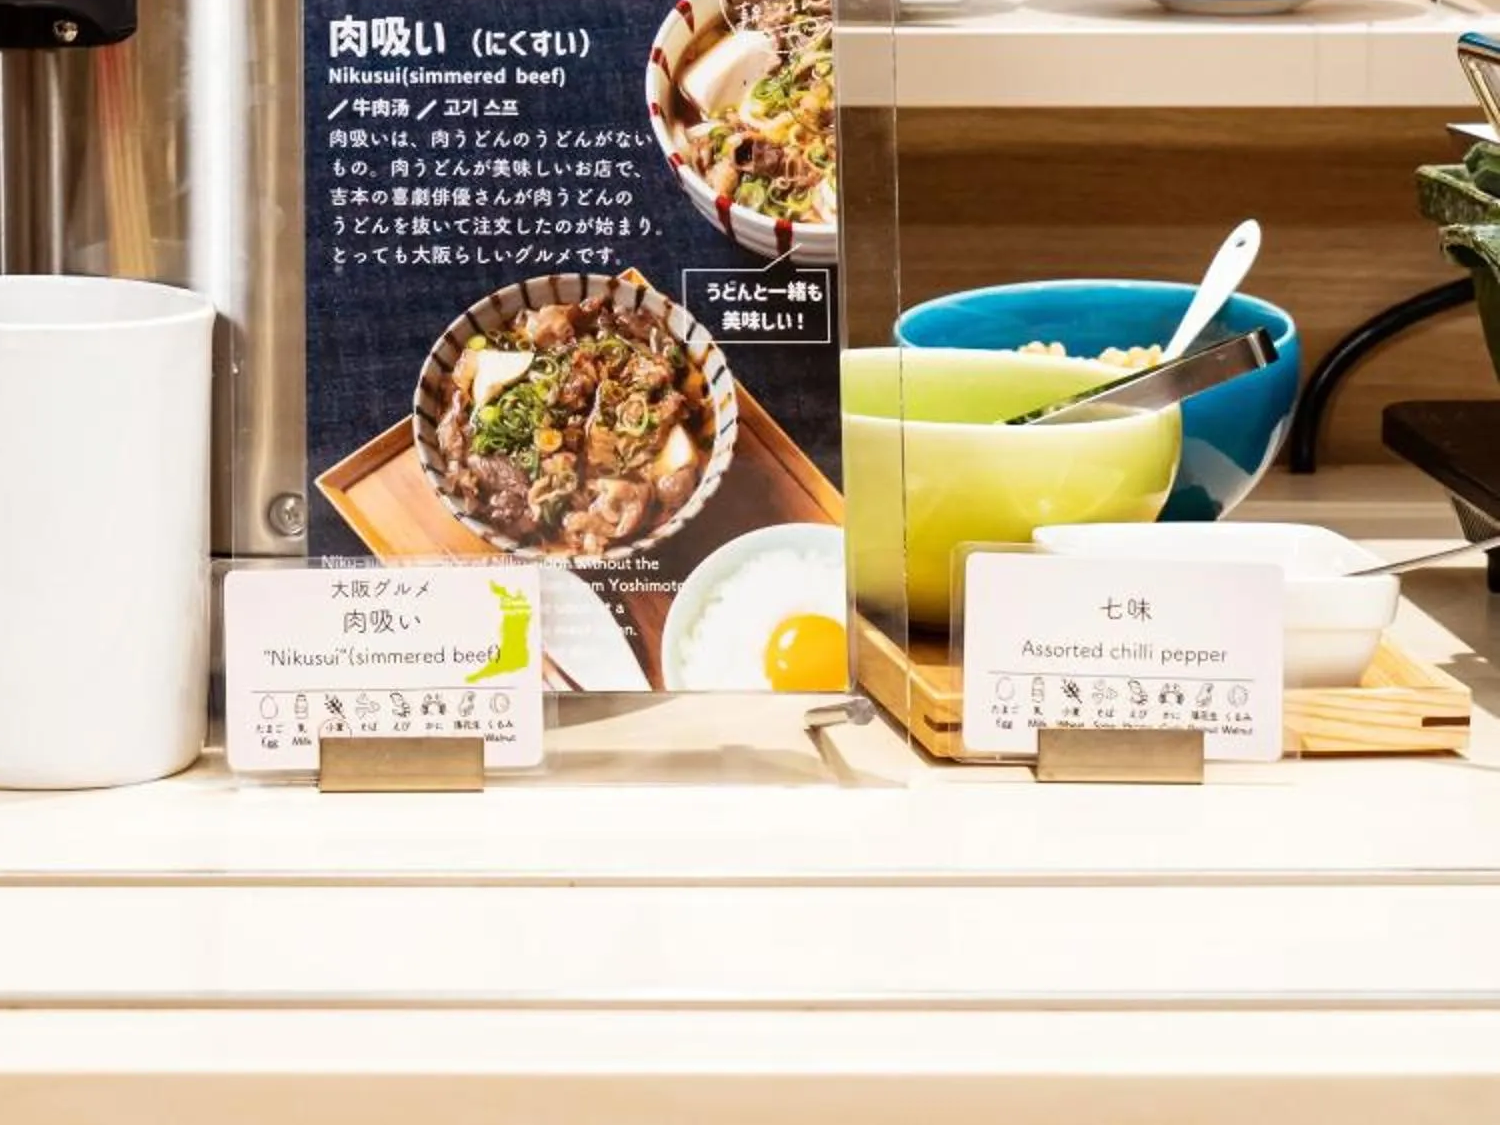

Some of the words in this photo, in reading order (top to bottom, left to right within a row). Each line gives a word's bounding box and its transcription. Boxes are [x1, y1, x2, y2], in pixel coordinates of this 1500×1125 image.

[328, 14, 447, 58] 肉吸い
[516, 66, 566, 88] beef)
[329, 187, 633, 207] 吉本の喜劇俳優さんが肉うどんの
[333, 216, 664, 236] うどんを抜いて注文したのが始まり。
[333, 246, 622, 265] とっても大阪らしいグルメです。
[706, 281, 824, 303] うどんと一緒も
[636, 555, 659, 572] the
[331, 578, 431, 599] 大阪グルメ
[1100, 596, 1152, 622] 七味
[343, 608, 421, 634] 肉吸い
[453, 643, 501, 665] beef)
[1021, 639, 1103, 660] Assorted
[1109, 642, 1154, 661] chilli
[1161, 646, 1228, 666] pepper
